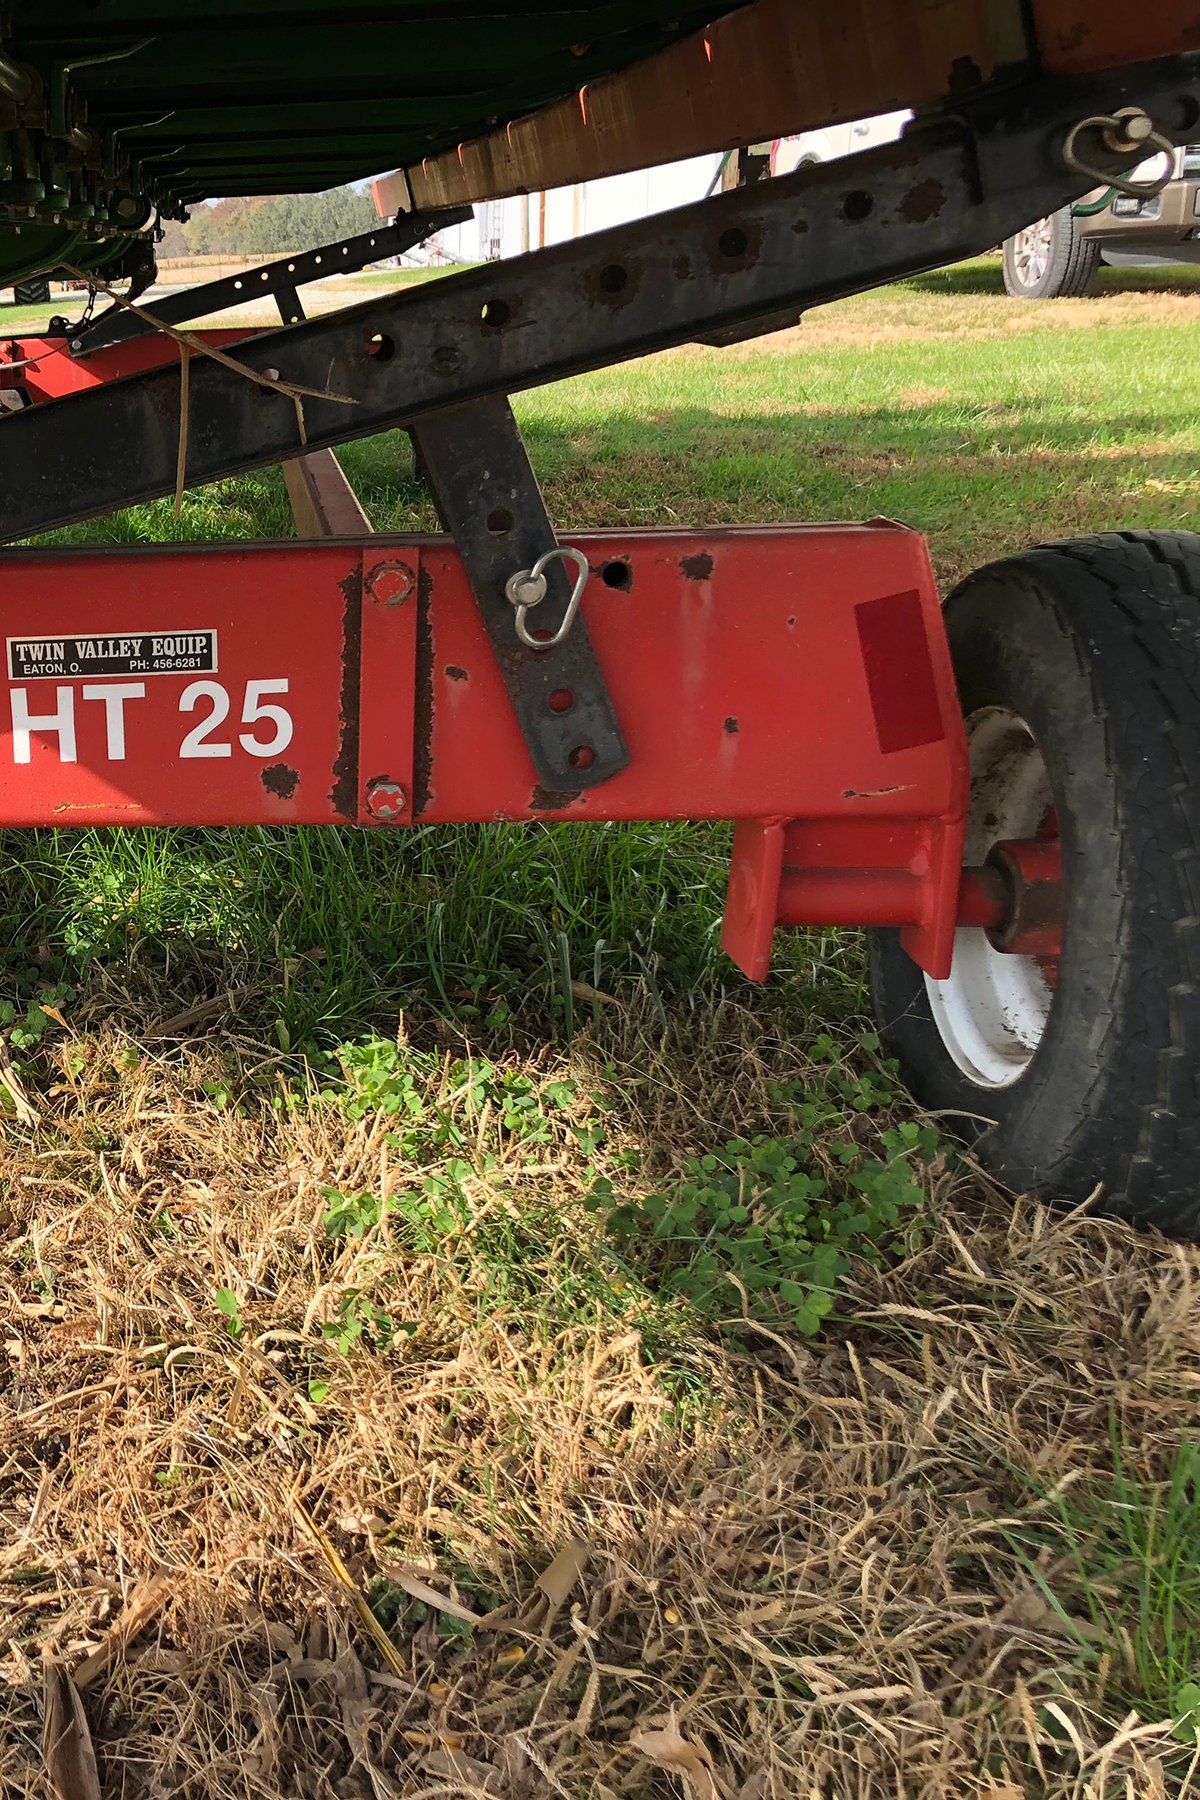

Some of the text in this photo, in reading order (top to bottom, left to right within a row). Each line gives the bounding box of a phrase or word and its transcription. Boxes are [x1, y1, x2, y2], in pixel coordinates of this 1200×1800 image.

[15, 636, 208, 661] TWIN VALLEY EQUIP.
[23, 657, 201, 675] EATON, O. PH: 456-6281
[9, 678, 294, 764] HT 25
